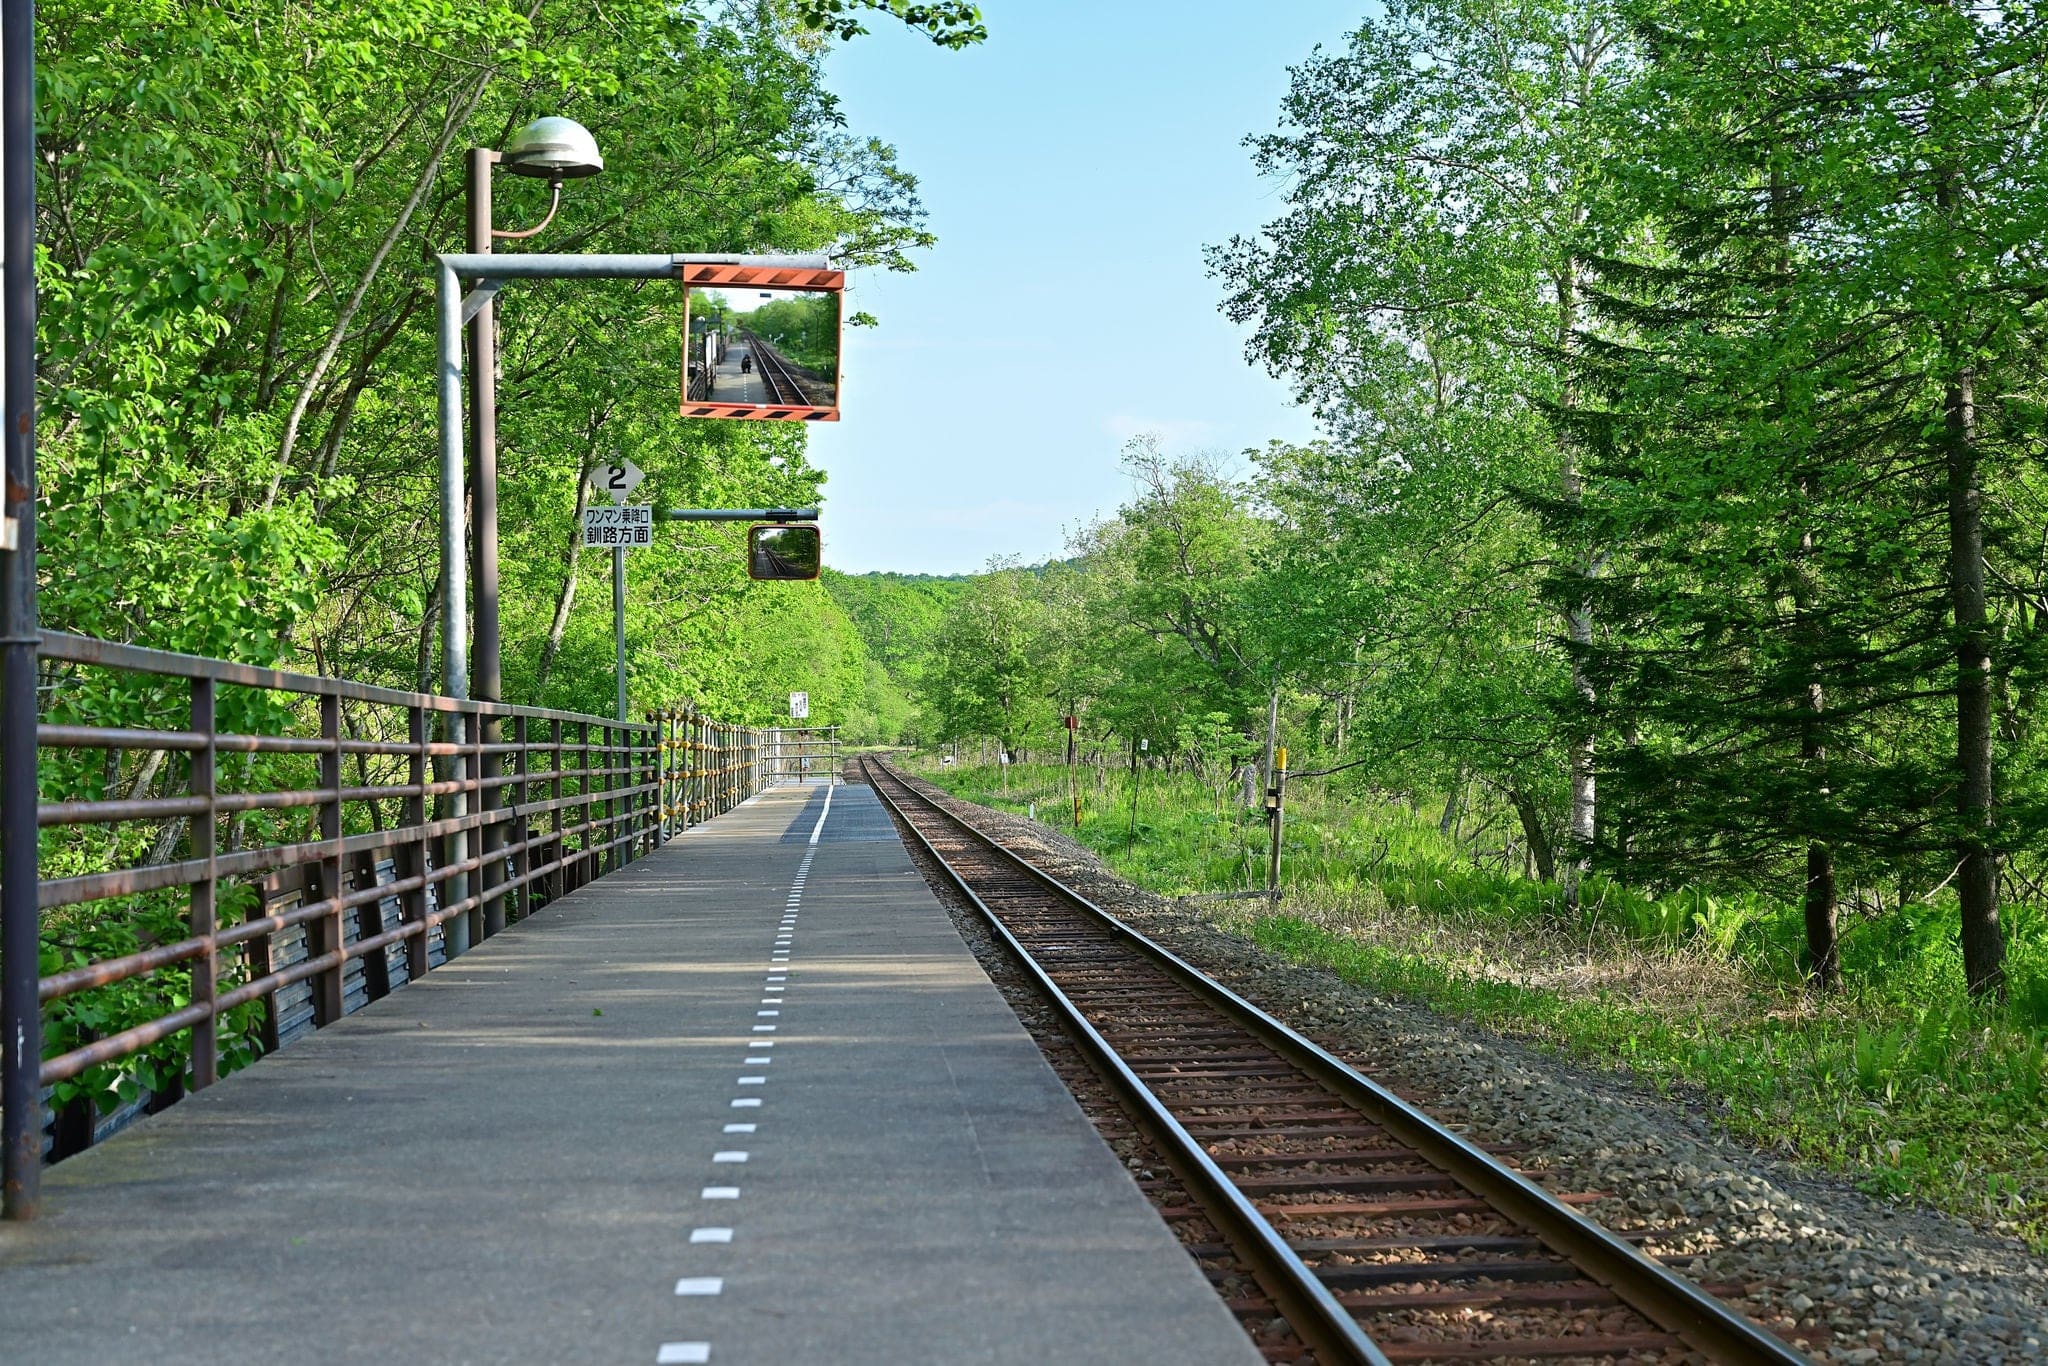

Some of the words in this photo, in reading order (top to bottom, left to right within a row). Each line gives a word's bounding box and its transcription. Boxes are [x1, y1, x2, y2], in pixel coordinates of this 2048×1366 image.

[608, 464, 626, 489] 2
[586, 508, 649, 525] ワンマン乗降口
[587, 526, 649, 544] 釧路方面
